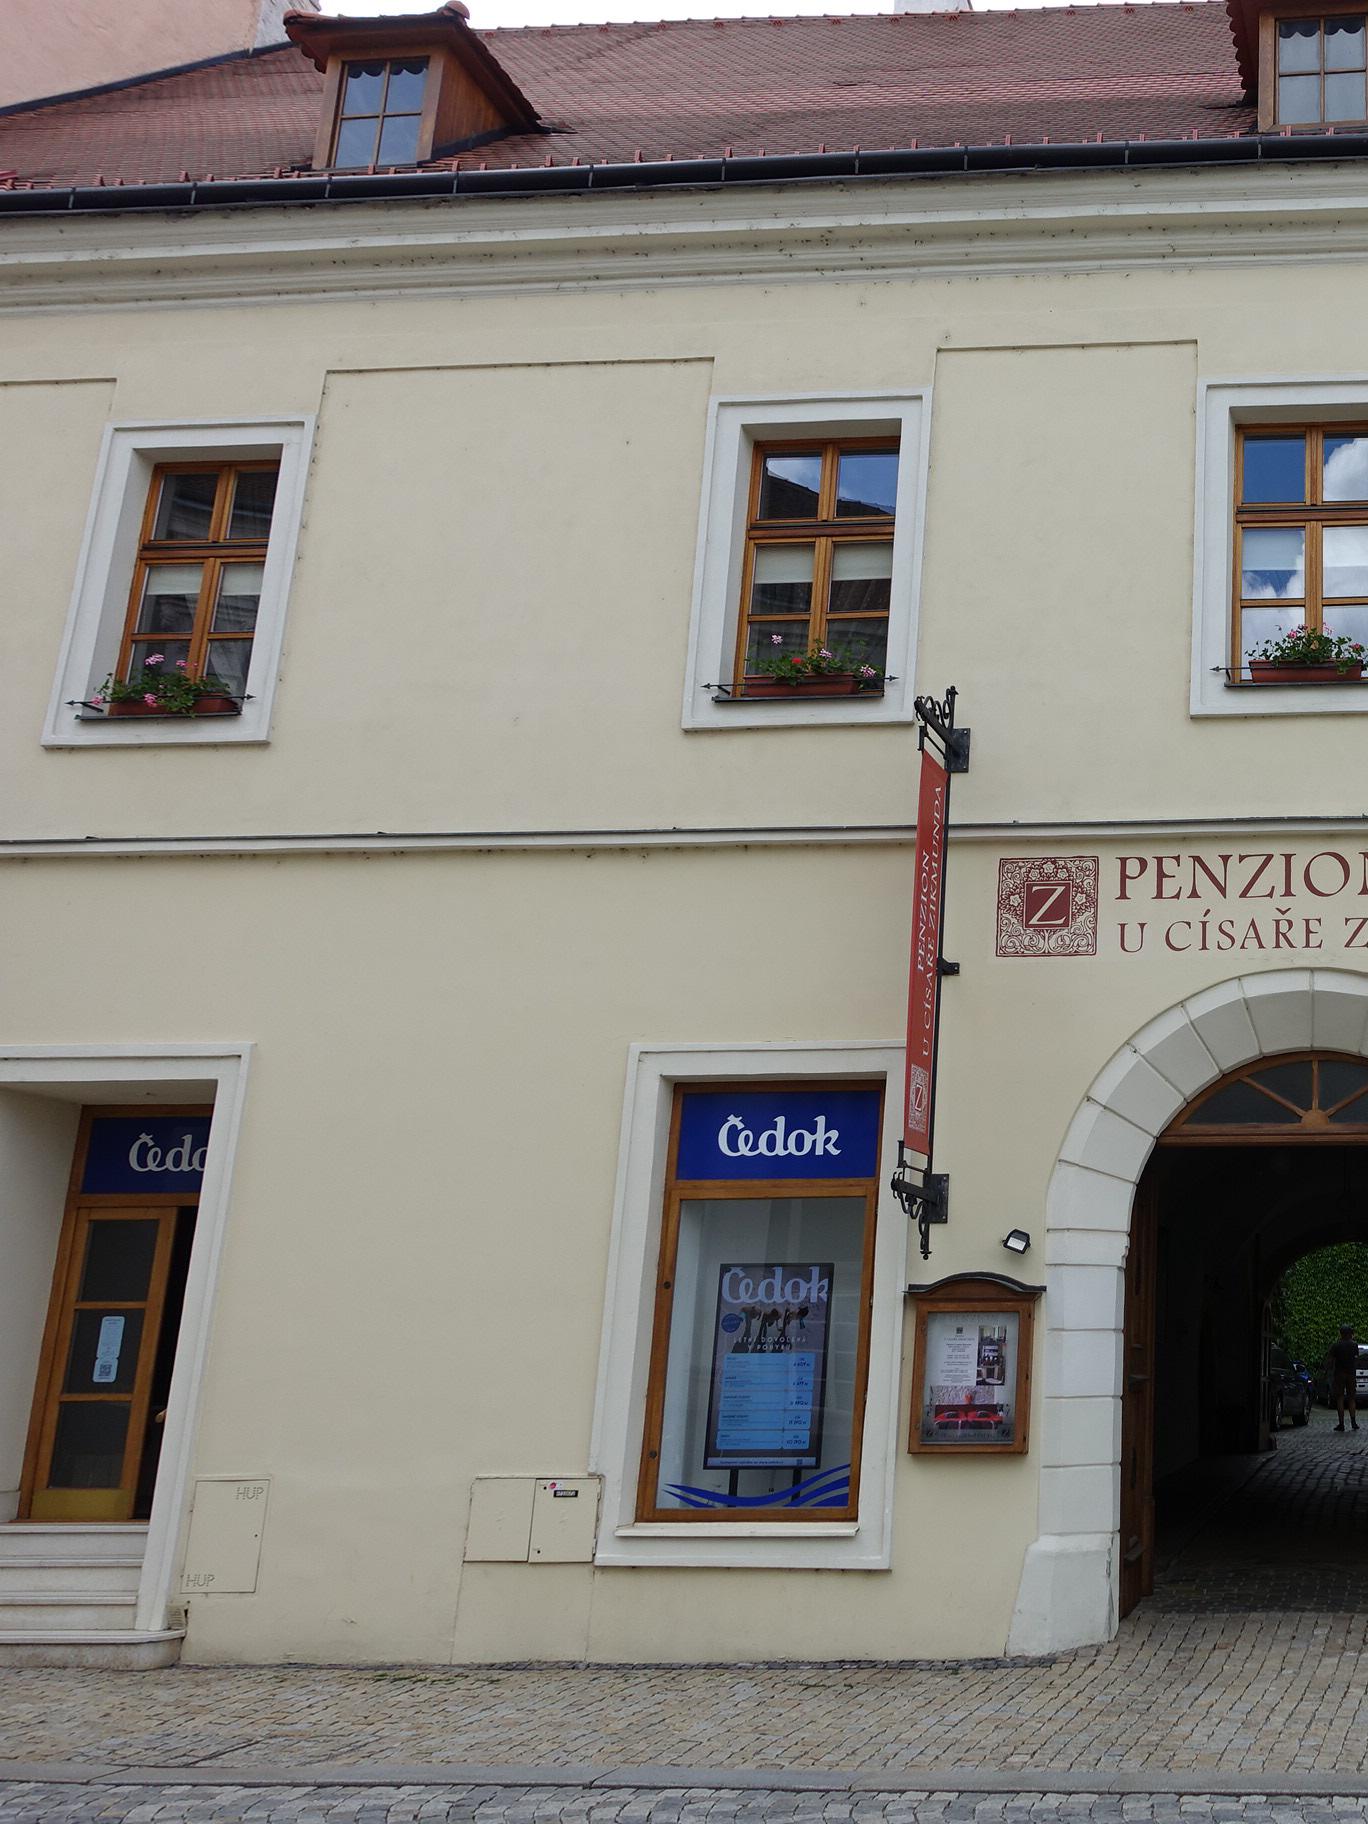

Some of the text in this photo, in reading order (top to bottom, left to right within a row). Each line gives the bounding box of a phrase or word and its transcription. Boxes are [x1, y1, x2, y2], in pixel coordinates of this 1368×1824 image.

[917, 850, 931, 972] PENZION
[922, 1038, 929, 1056] U
[928, 786, 942, 929] ZIKMUNDA
[1028, 885, 1067, 926] Z
[1118, 922, 1148, 953] U
[1165, 907, 1323, 952] CÍSAŘE
[718, 1114, 842, 1157] Čedok
[722, 1266, 829, 1304] Čedok
[236, 1486, 265, 1501] HUP
[186, 1573, 215, 1588] HUP
